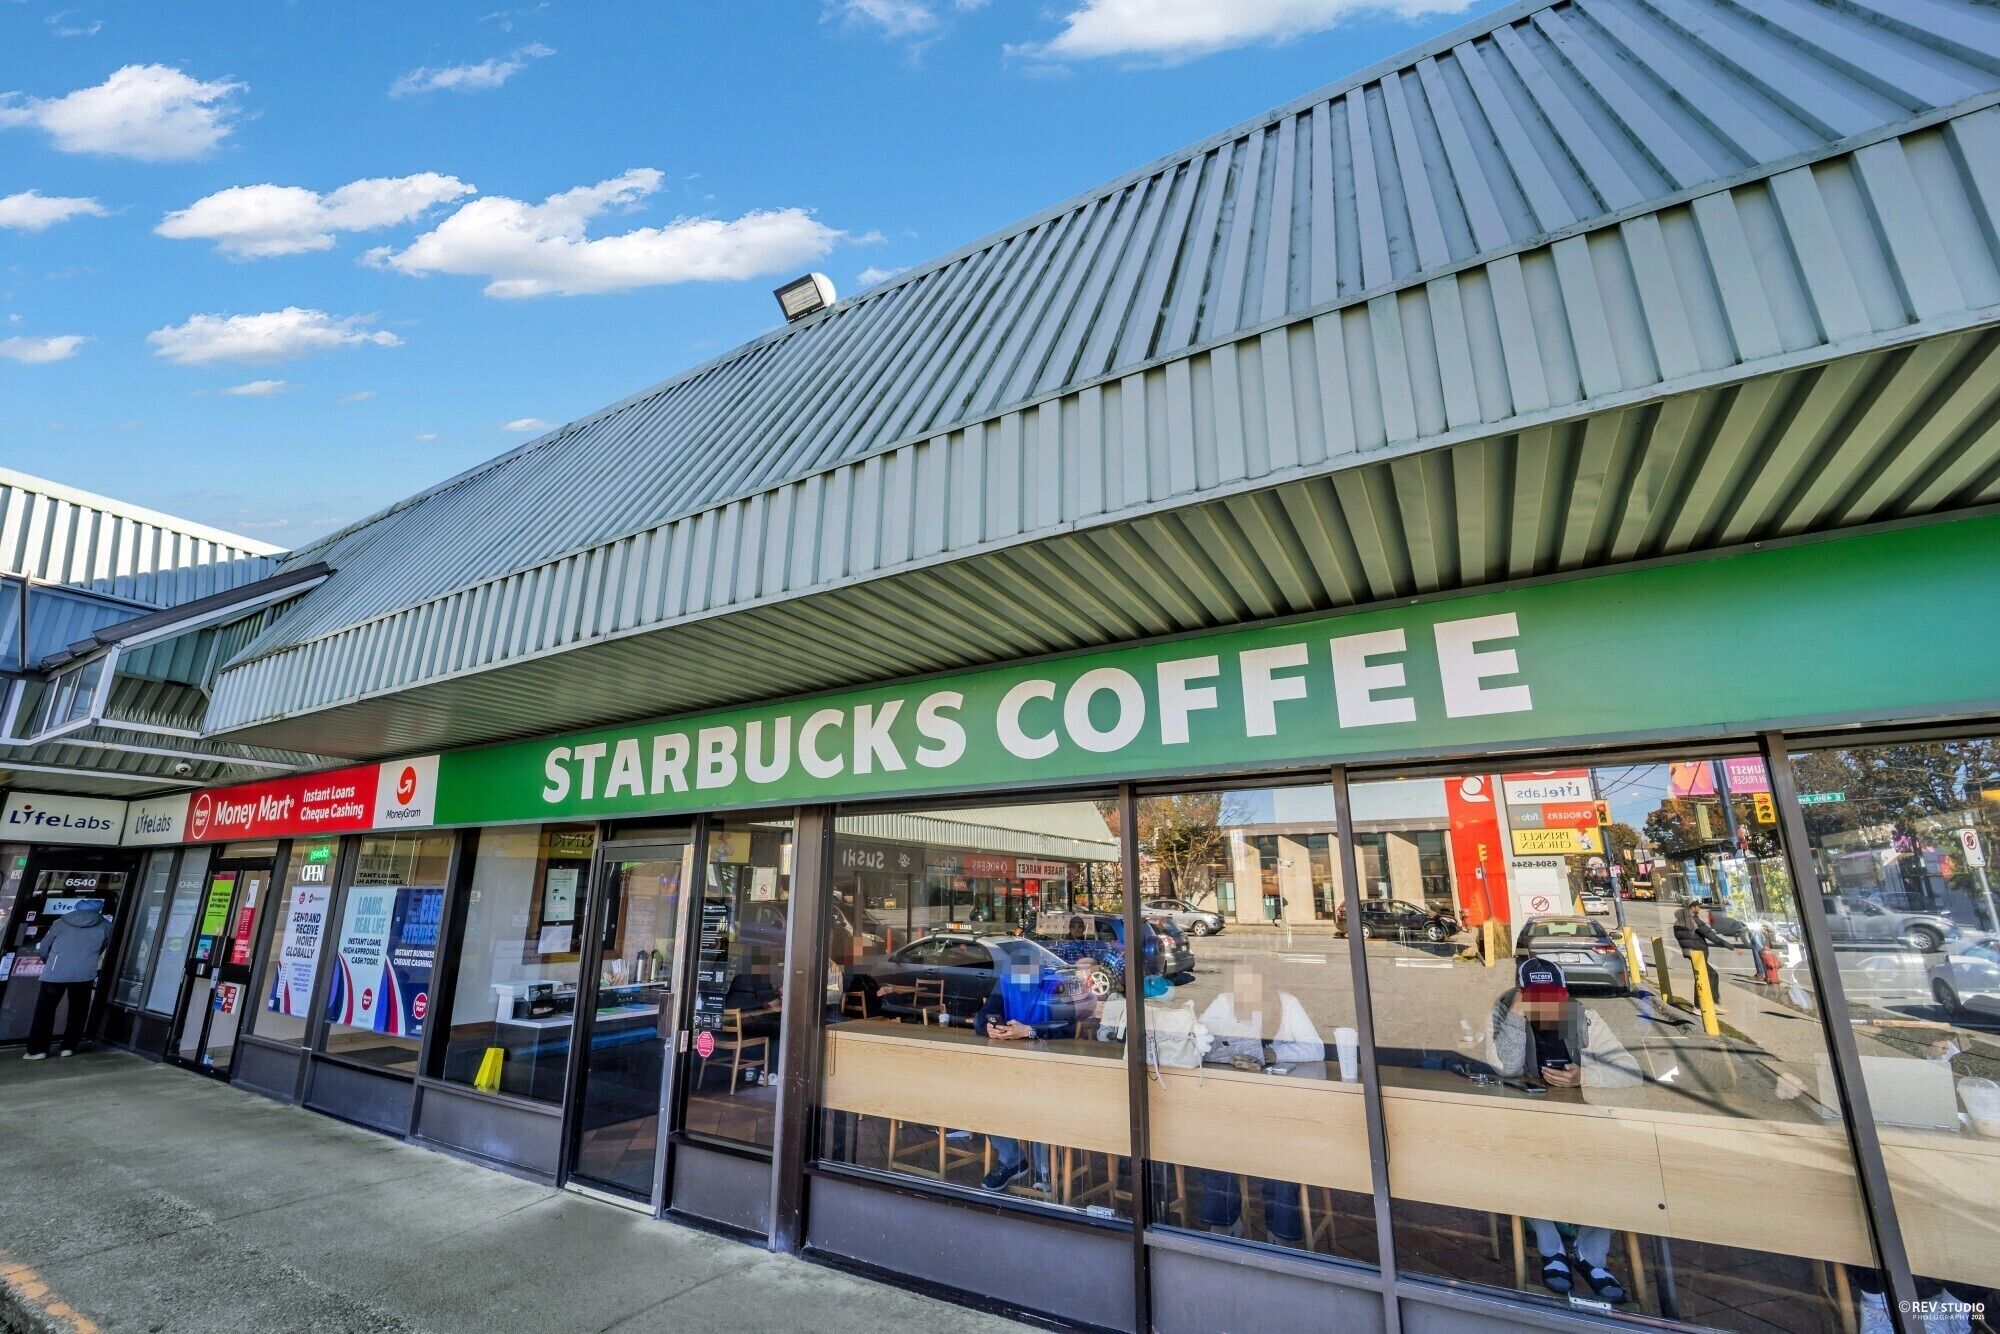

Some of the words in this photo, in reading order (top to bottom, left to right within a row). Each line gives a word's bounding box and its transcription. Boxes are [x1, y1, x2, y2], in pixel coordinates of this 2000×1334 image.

[542, 690, 967, 804] STARBUCKS
[996, 611, 1533, 760] COFFEE
[303, 788, 331, 803] Instant
[332, 785, 355, 800] Loans
[9, 804, 112, 831] LifeLabs
[214, 800, 257, 829] Money
[301, 805, 329, 823] Cheque
[330, 803, 364, 821] Cashing
[385, 807, 421, 820] MoneyGram
[135, 808, 172, 834] LifeLabs
[302, 864, 325, 882] OPEN
[65, 878, 96, 887] 6540
[53, 902, 75, 911] Life
[419, 894, 443, 924] BIG
[293, 912, 309, 923] SEND
[309, 913, 321, 924] AND
[295, 924, 319, 936] RECEIVE
[295, 935, 317, 948] MONEY
[347, 937, 366, 946] INSTANT
[285, 947, 315, 959] GLOBALLY
[394, 949, 413, 957] INSTANT
[413, 950, 435, 958] BUSINESS
[351, 957, 364, 965] CASH
[393, 957, 411, 966] CHEQUE
